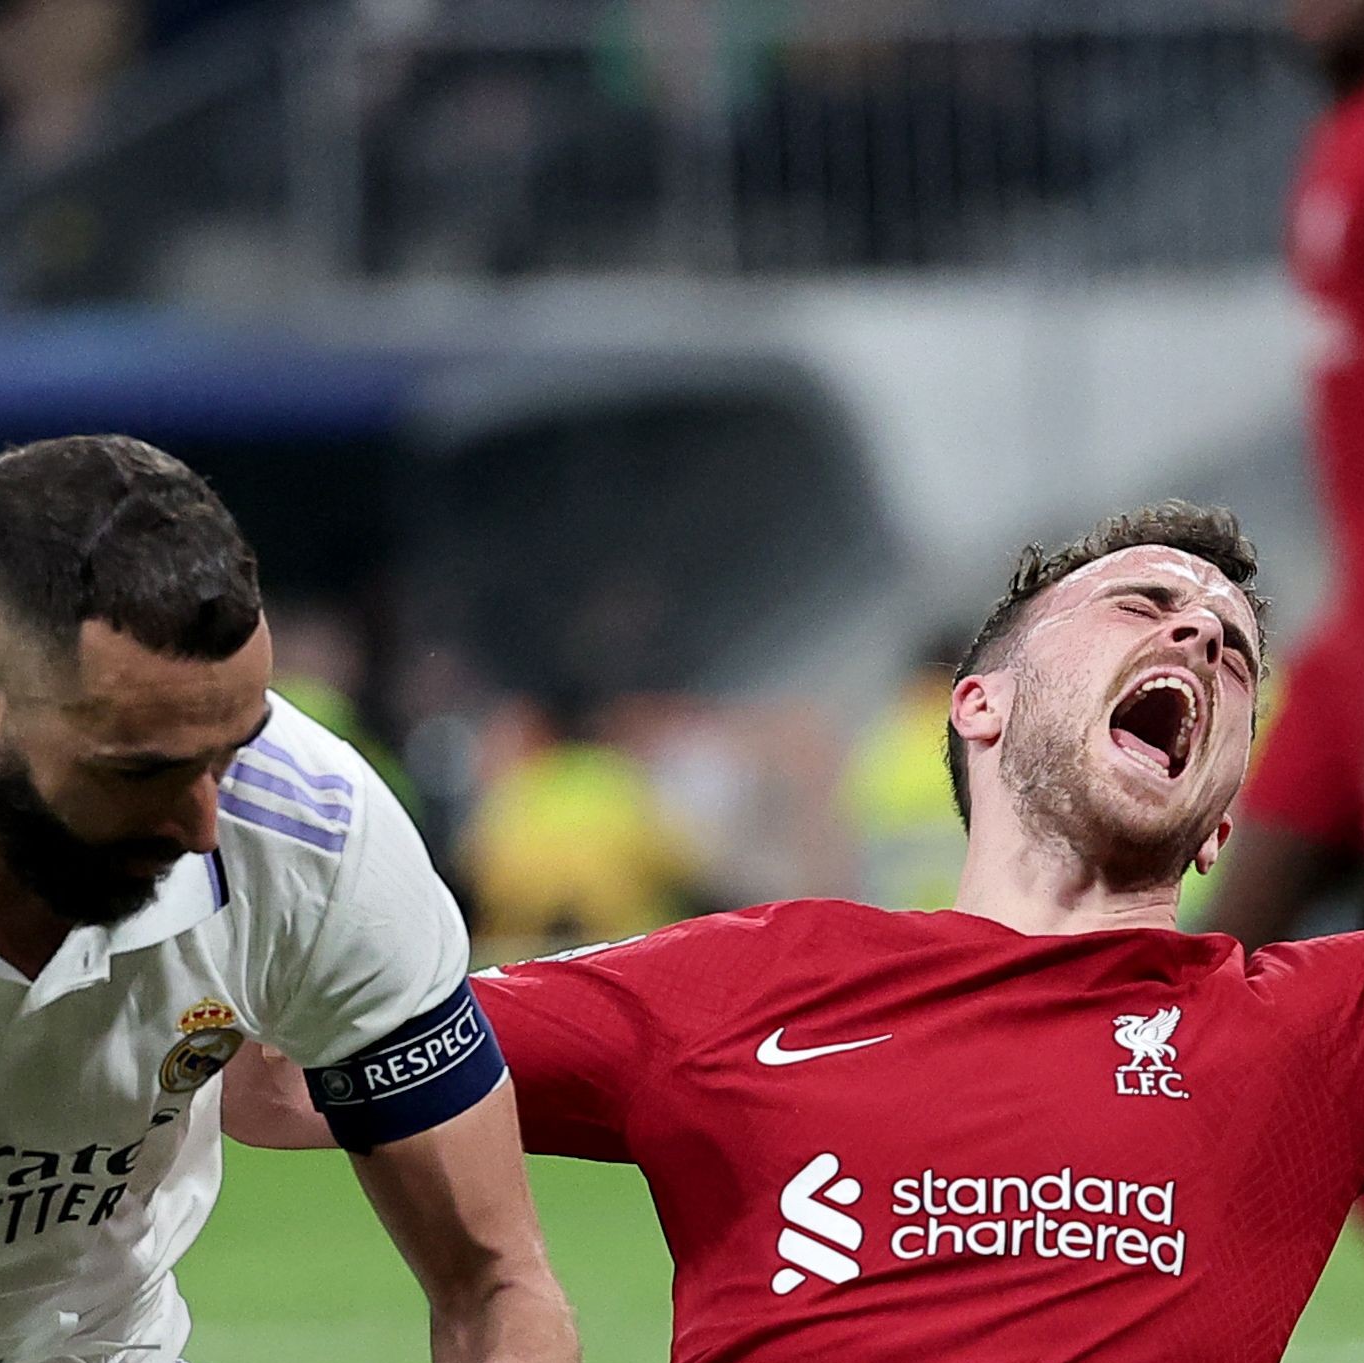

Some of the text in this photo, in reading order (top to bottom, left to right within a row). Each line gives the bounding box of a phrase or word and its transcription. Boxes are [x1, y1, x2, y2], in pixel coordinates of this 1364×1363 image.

[363, 1005, 479, 1090] RESPECT
[1114, 1072, 1190, 1099] L.F.C.
[892, 1166, 1175, 1226] standard
[890, 1210, 1185, 1277] chartered
